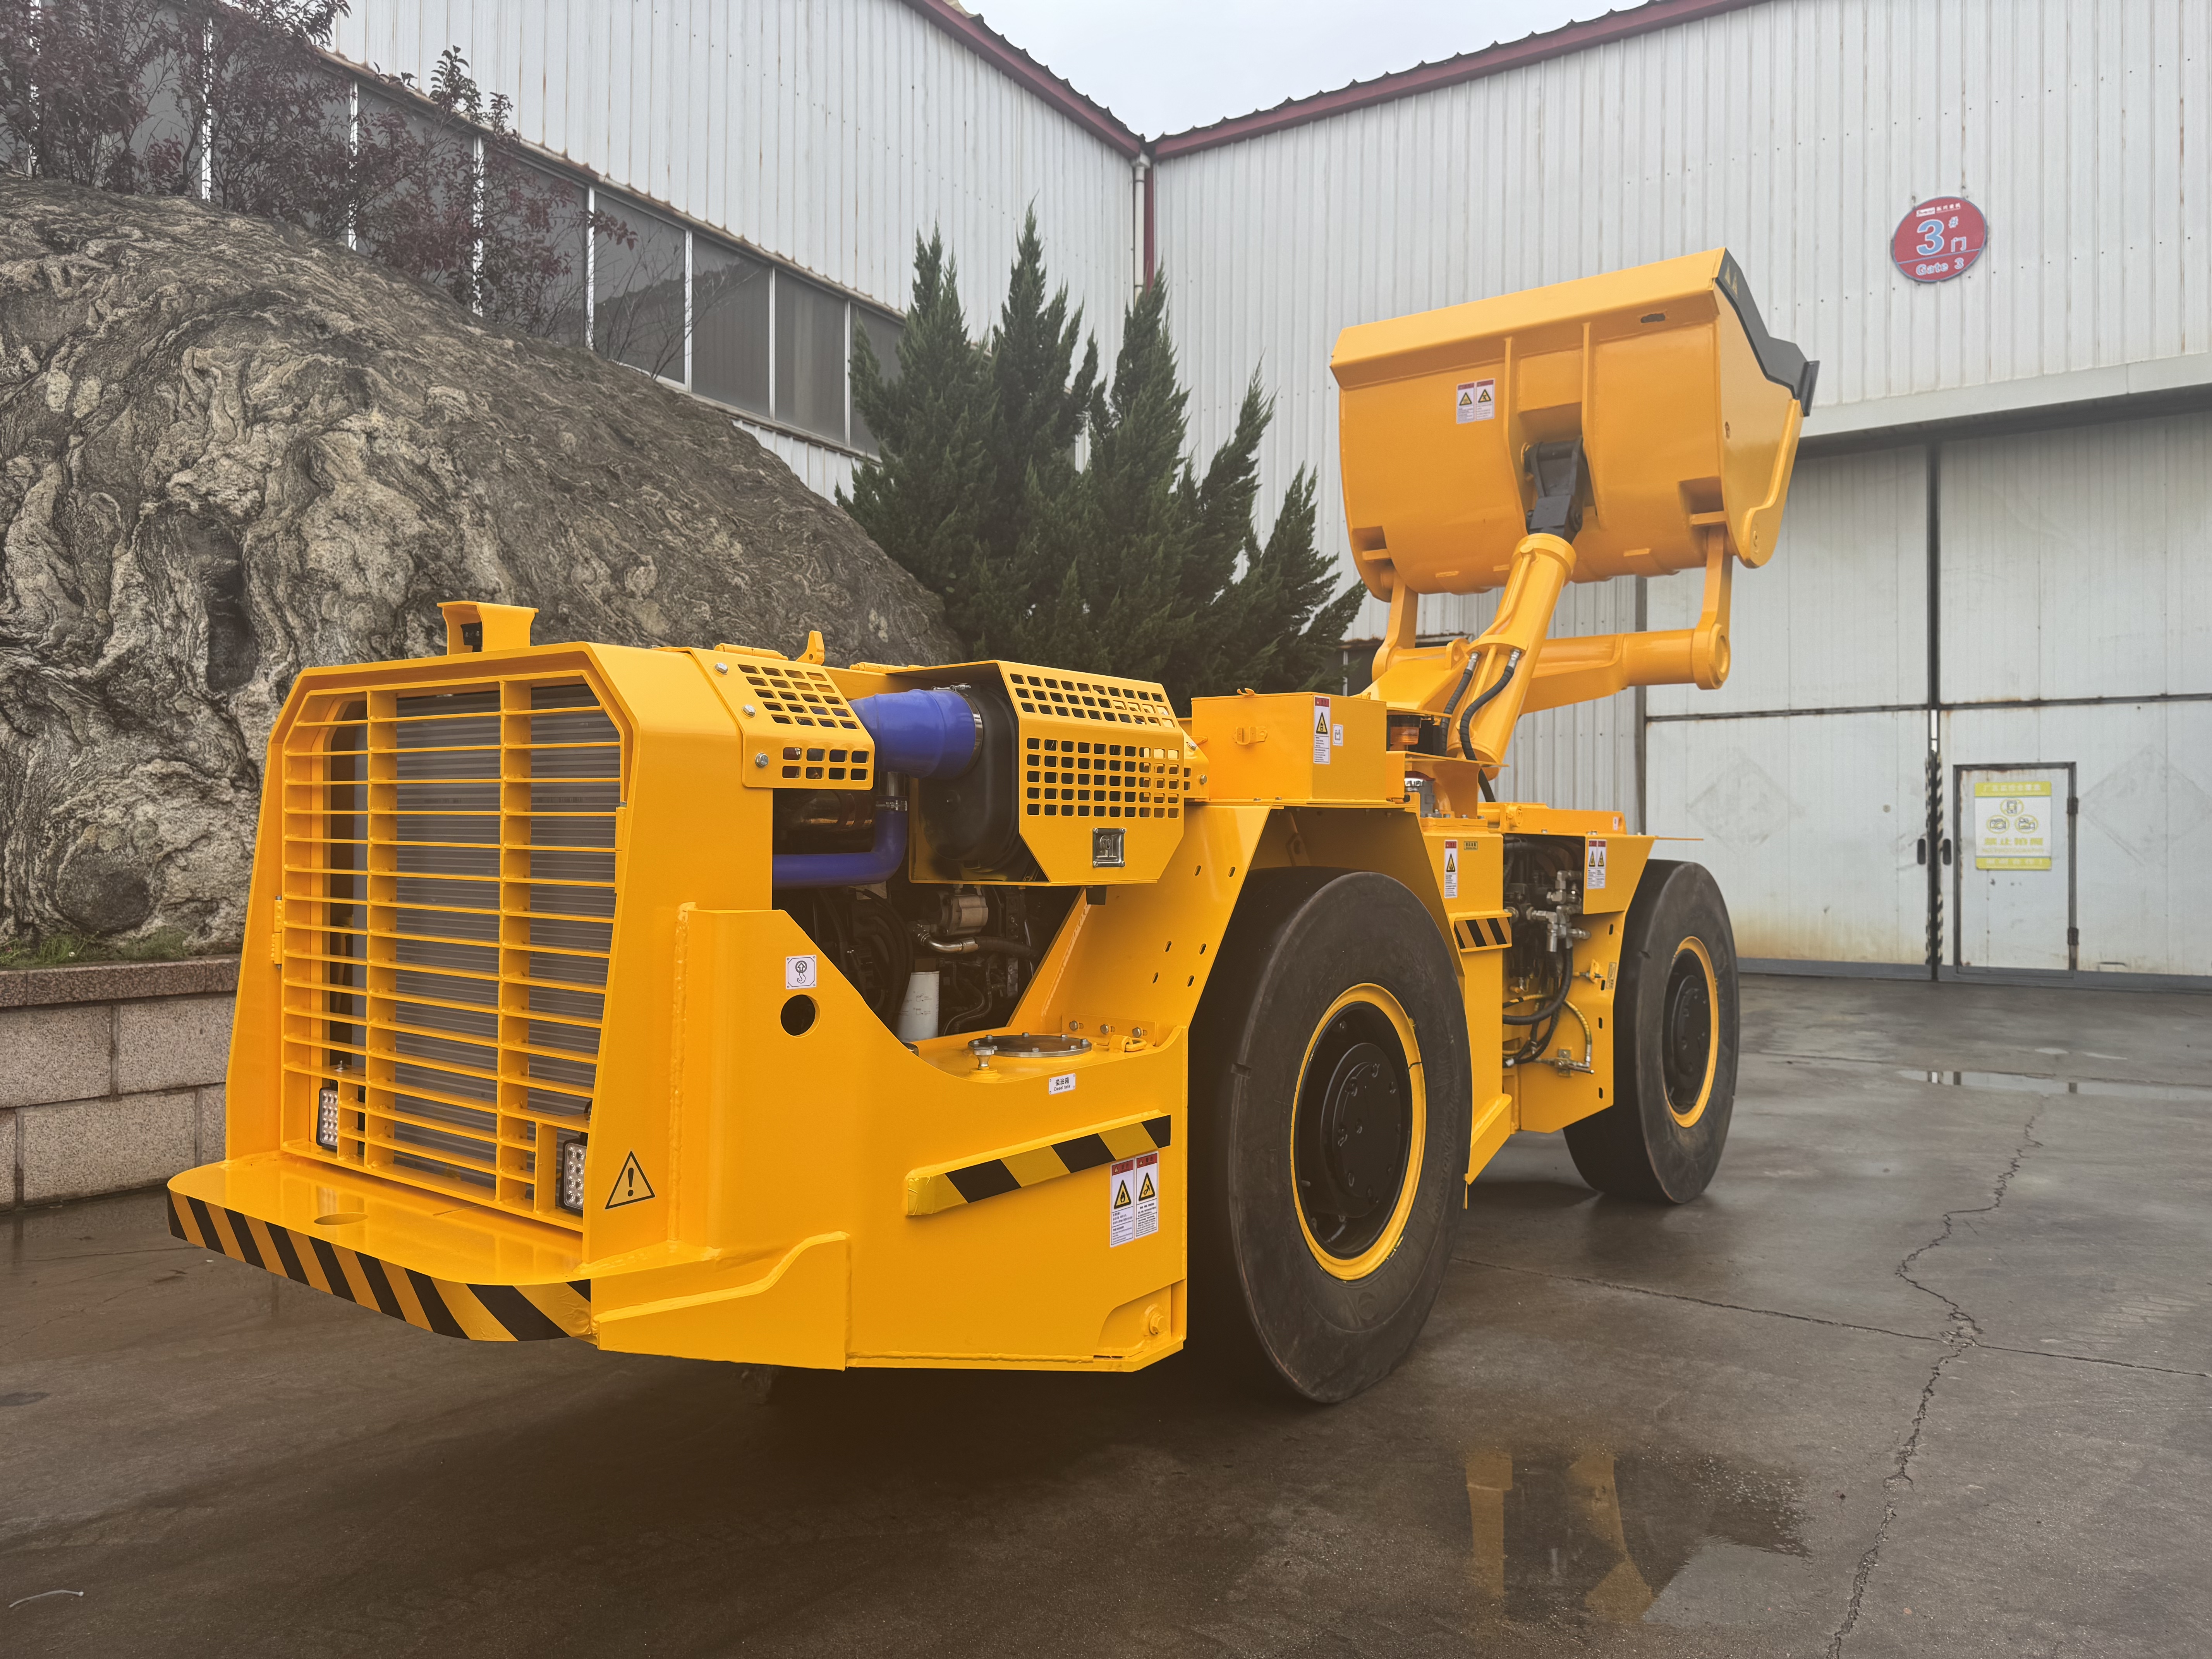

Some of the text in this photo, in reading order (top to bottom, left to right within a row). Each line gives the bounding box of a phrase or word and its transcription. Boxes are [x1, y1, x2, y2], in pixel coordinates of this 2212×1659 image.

[1916, 219, 1944, 256] 3
[1951, 236, 1966, 252] 门
[1916, 257, 1964, 275] Gate 3
